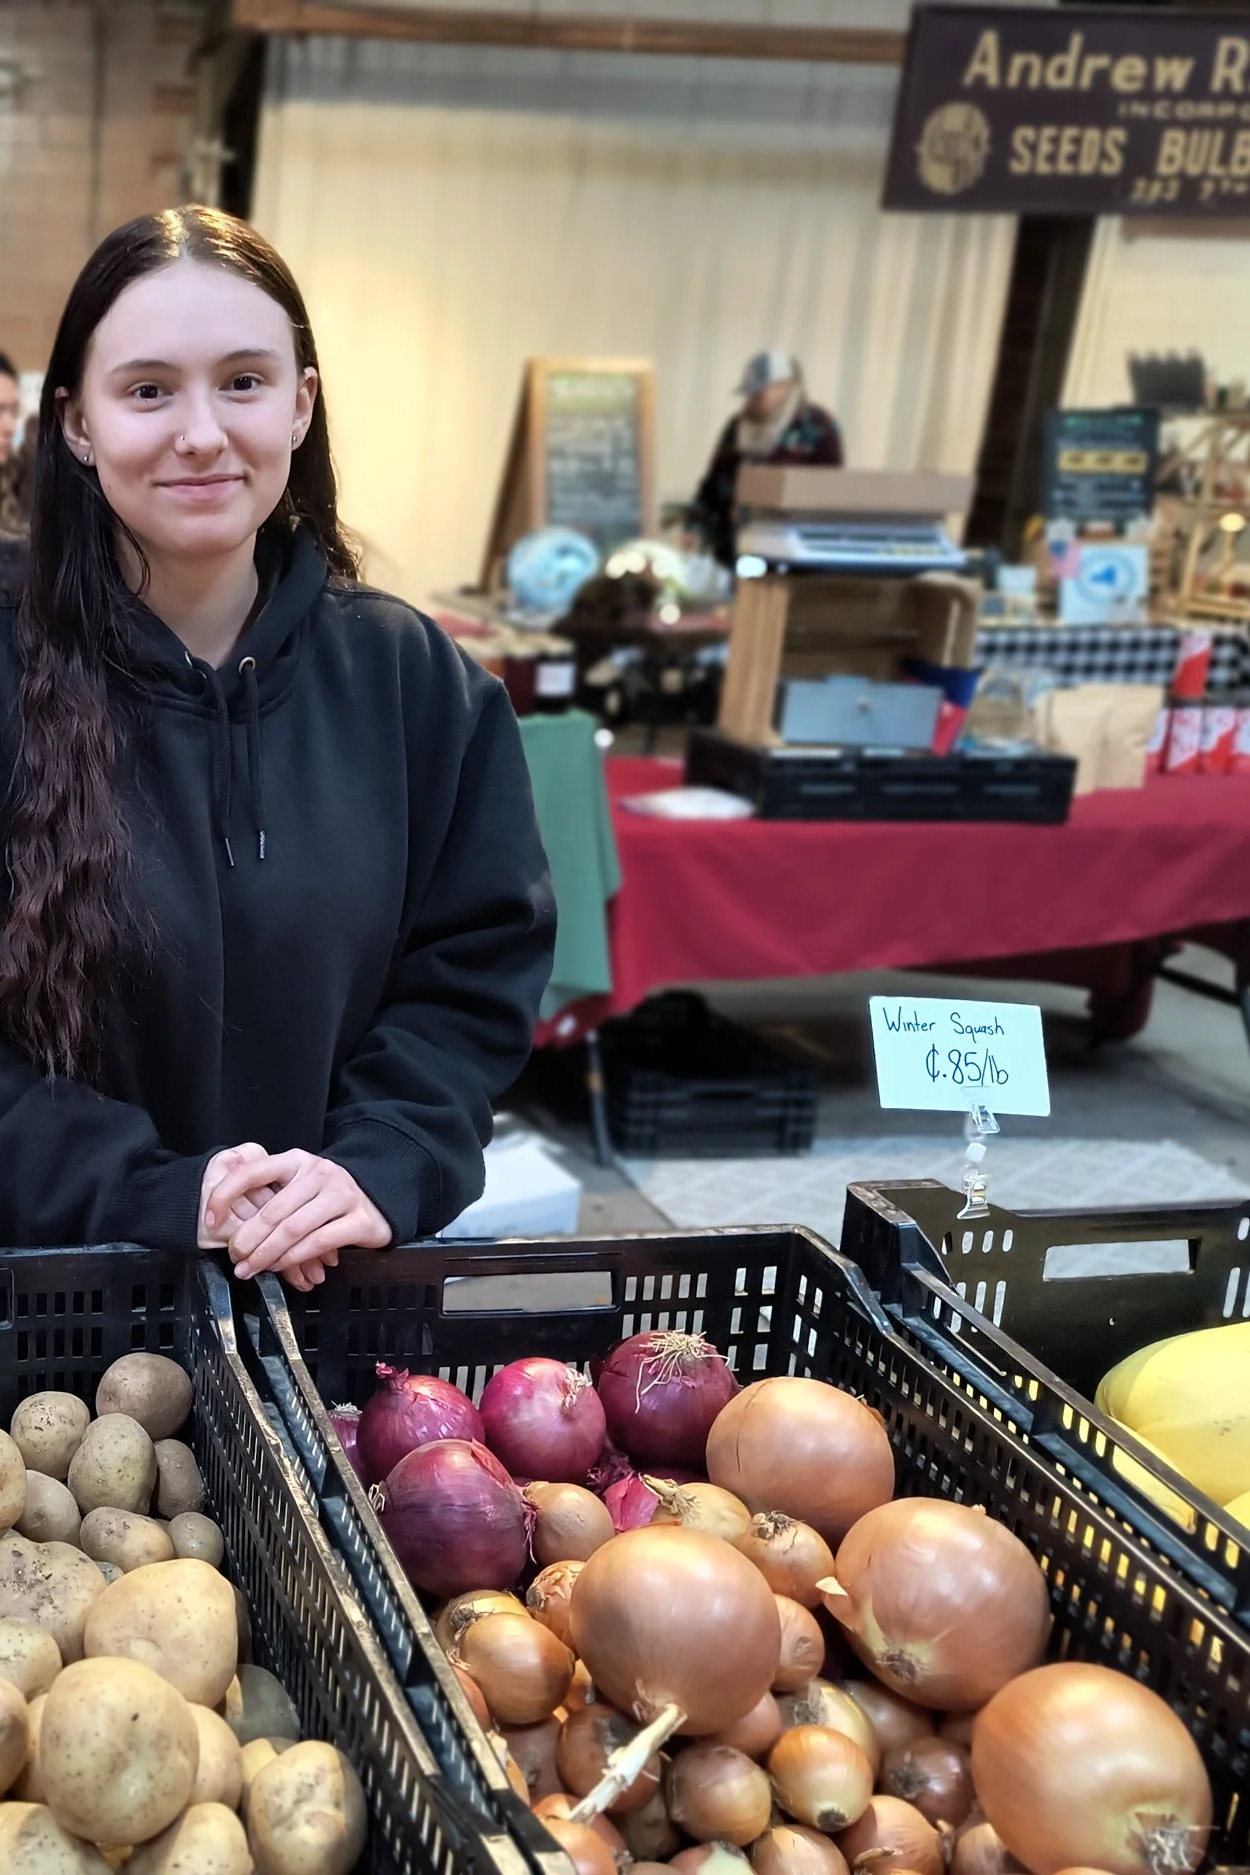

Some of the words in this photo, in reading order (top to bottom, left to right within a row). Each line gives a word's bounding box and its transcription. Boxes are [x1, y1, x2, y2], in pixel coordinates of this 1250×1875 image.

[962, 29, 1194, 92] Andrew
[1009, 126, 1128, 176] SEEDS
[882, 1006, 936, 1033] Winter
[949, 1011, 1005, 1044] Squash
